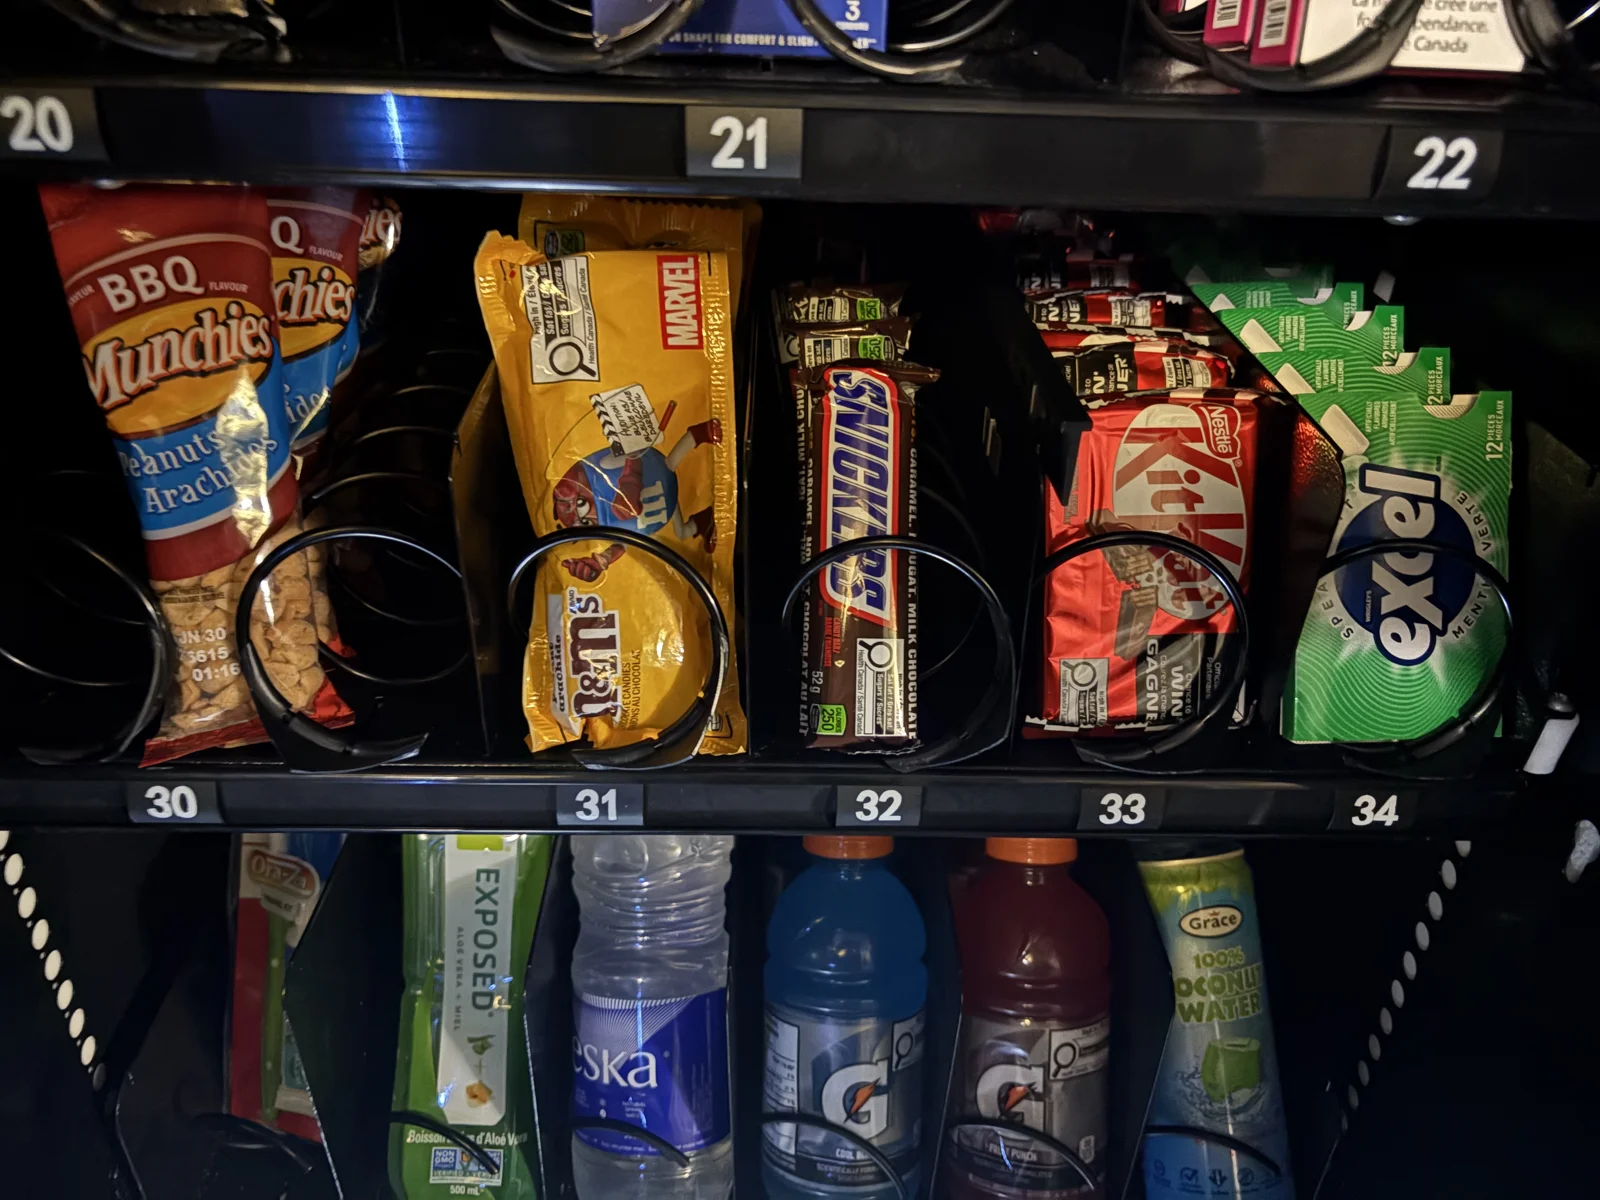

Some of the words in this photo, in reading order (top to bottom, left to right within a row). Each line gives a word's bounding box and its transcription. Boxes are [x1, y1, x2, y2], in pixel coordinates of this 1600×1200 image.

[715, 33, 732, 44] FOR
[734, 34, 776, 46] COMFORT
[1413, 36, 1469, 53] Canada
[0, 96, 74, 152] 20
[709, 115, 768, 170] 21
[1406, 136, 1479, 190] 22
[308, 245, 345, 262] FLAVOUR
[98, 255, 205, 313] BBQ
[208, 281, 249, 294] FLAVOUR
[274, 266, 357, 324] chies
[578, 267, 588, 293] Canada
[661, 256, 700, 347] MARVEL
[866, 300, 878, 319] 250
[585, 316, 596, 341] Canada
[1382, 326, 1390, 350] PIECES
[1390, 314, 1398, 350] MORCEAUX
[82, 300, 275, 412] Munchies
[869, 337, 881, 360] 250
[1427, 369, 1436, 394] PIECES
[1436, 356, 1444, 396] MORCEAUX
[1486, 413, 1495, 439] PIECES
[1495, 400, 1504, 440] MORCEAUX
[1485, 439, 1504, 461] 12
[831, 370, 890, 612] SNICKERS
[908, 447, 918, 528] CARAMEL.
[1456, 491, 1492, 552] VERTE
[1364, 468, 1443, 661] excel
[907, 602, 918, 645] MILK
[555, 634, 567, 713] arachide
[630, 649, 642, 695] CHOCOLAT
[857, 650, 865, 668] Health
[620, 661, 631, 699] CANDIES
[811, 671, 823, 685] 52
[875, 673, 884, 696] Sugars
[907, 648, 918, 740] CHOCOLATE
[1145, 638, 1160, 723] GAGNE
[1170, 665, 1184, 717] WIN
[631, 694, 641, 707] AU
[876, 702, 884, 725] Sucres
[821, 708, 834, 731] 250
[144, 785, 198, 819] 30
[574, 788, 618, 821] 31
[854, 789, 903, 822] 32
[1098, 792, 1147, 825] 33
[1351, 794, 1399, 827] 34
[1188, 914, 1237, 930] Grace
[471, 867, 500, 1011] EXPOSED
[455, 958, 464, 988] VERA
[1193, 945, 1245, 969] 100%
[453, 1005, 462, 1032] MIEL
[1177, 991, 1262, 1024] WATER
[572, 1036, 658, 1089] eska
[821, 1057, 889, 1140] G
[434, 1156, 455, 1164] GMO
[435, 1149, 455, 1157] NON
[449, 1184, 466, 1195] 500
